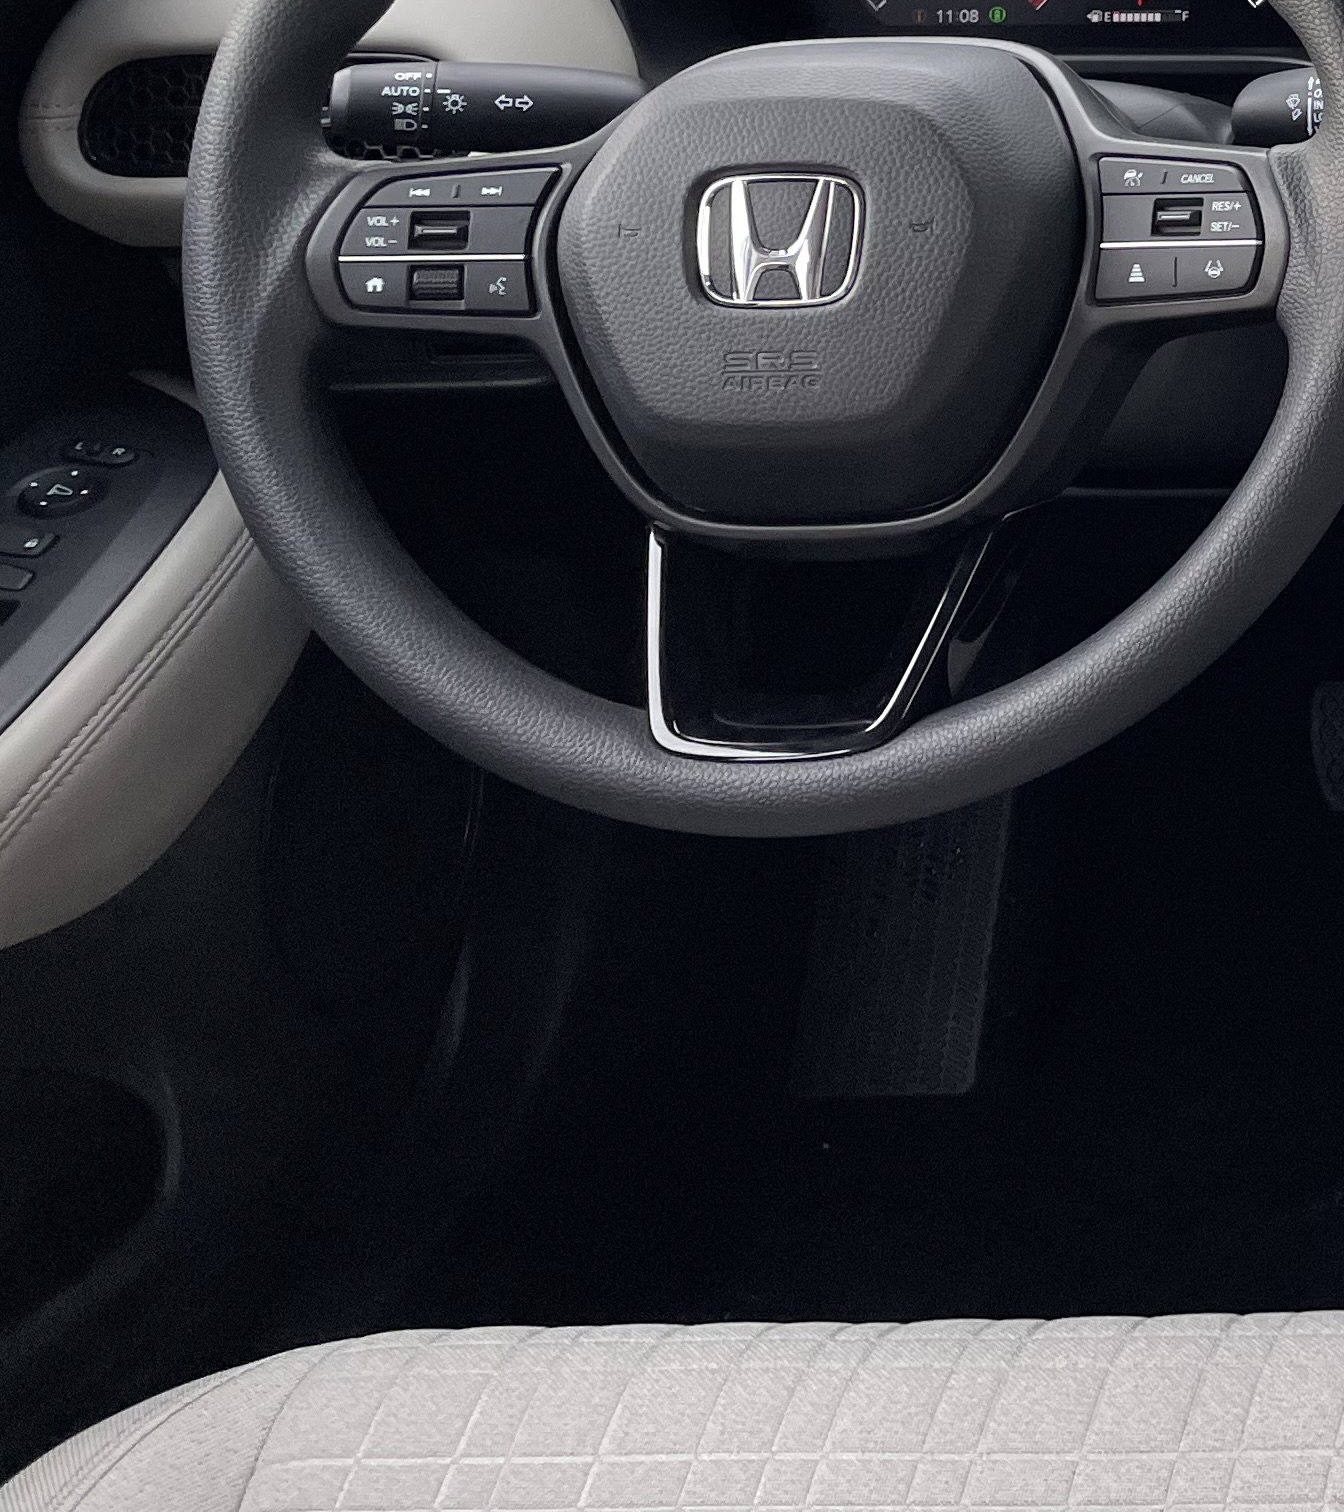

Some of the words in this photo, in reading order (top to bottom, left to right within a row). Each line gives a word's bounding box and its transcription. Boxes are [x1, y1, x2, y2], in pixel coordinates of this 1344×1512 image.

[936, 9, 979, 23] 11:08
[1104, 11, 1111, 22] E
[1182, 10, 1190, 21] F
[395, 72, 421, 80] OFF
[381, 86, 420, 96] AUTO
[1181, 173, 1214, 184] CANCEL
[1212, 201, 1241, 211] RES/+
[723, 351, 818, 371] SRS
[722, 374, 821, 390] AIRBAG
